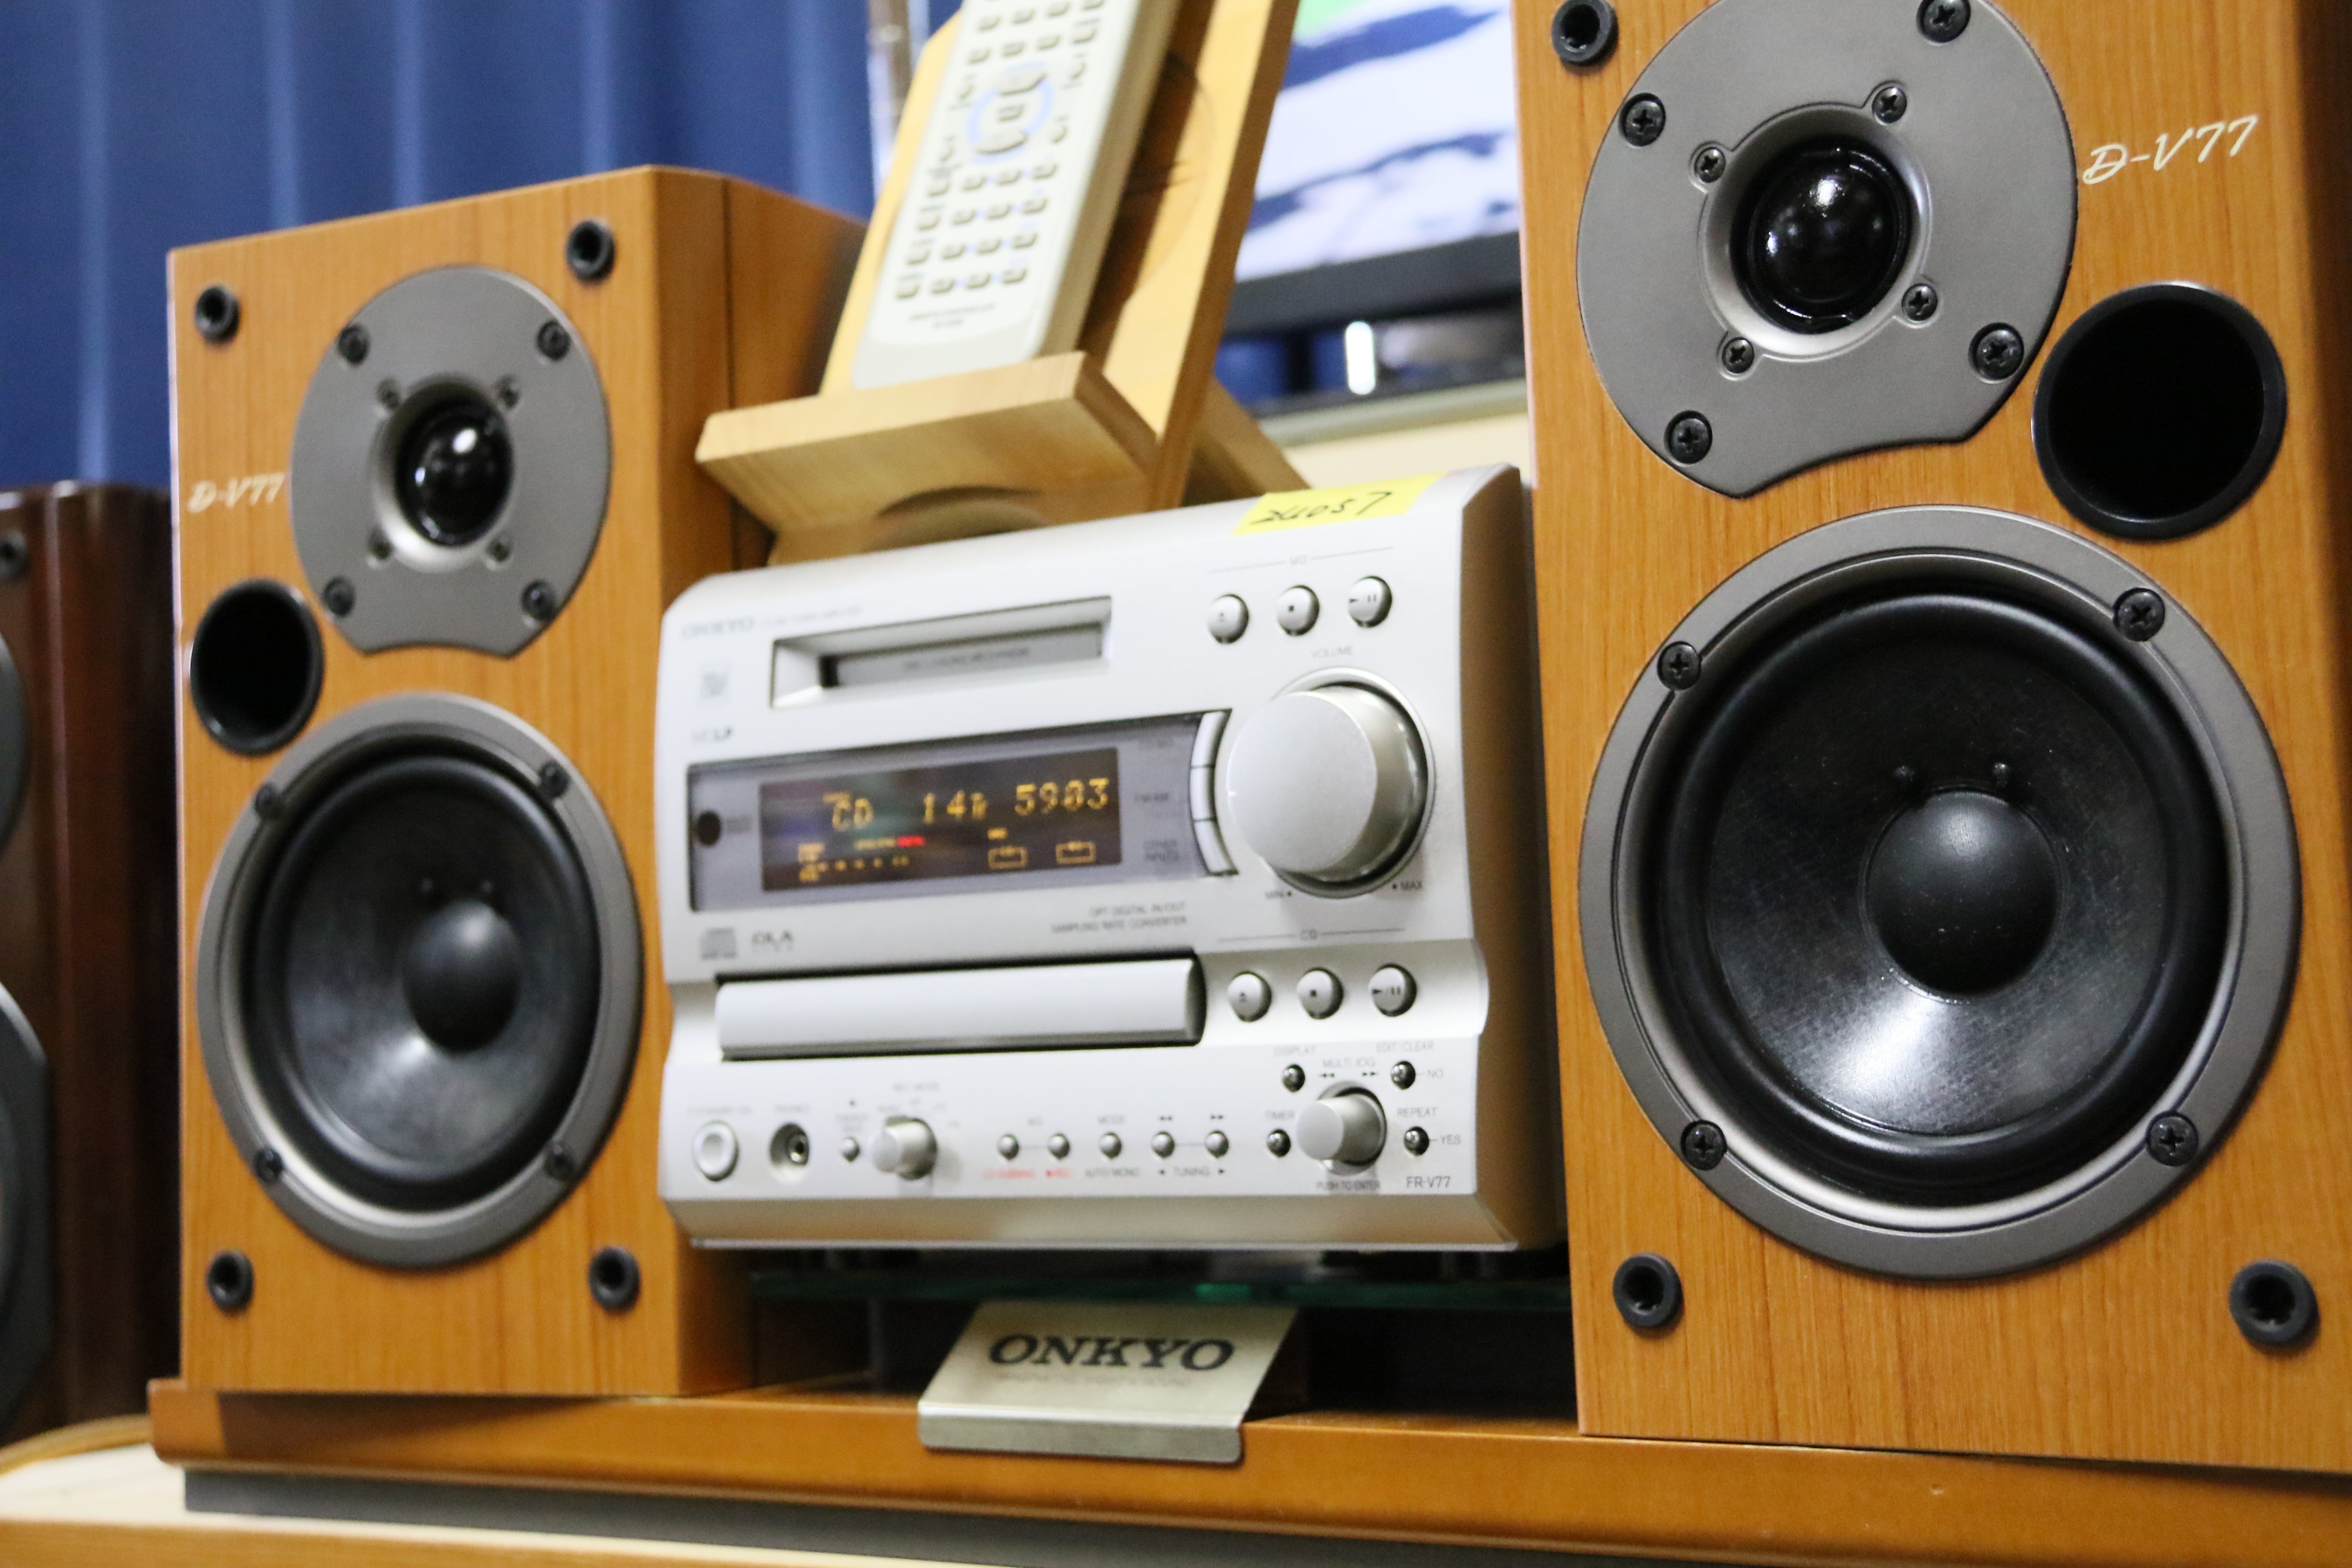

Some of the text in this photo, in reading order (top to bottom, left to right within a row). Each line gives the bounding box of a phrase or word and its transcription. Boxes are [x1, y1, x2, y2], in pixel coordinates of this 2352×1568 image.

[2082, 114, 2258, 184] D-V77
[188, 471, 285, 513] D-V77
[1311, 644, 1353, 659] VOLUME
[1400, 880, 1422, 890] MAX
[1300, 929, 1317, 939] CD
[1273, 1045, 1316, 1056] DISPLAY
[1322, 1058, 1375, 1067] MULTI JOG
[1427, 1069, 1444, 1078] NO
[1265, 1111, 1295, 1120] TIMER
[1397, 1106, 1437, 1117] REPEAT
[1440, 1135, 1461, 1146] YES
[1173, 1167, 1210, 1177] TUNING
[1354, 1181, 1380, 1190] ENTER
[1406, 1176, 1451, 1189] FR-V77
[989, 1334, 1235, 1371] ONKYO
